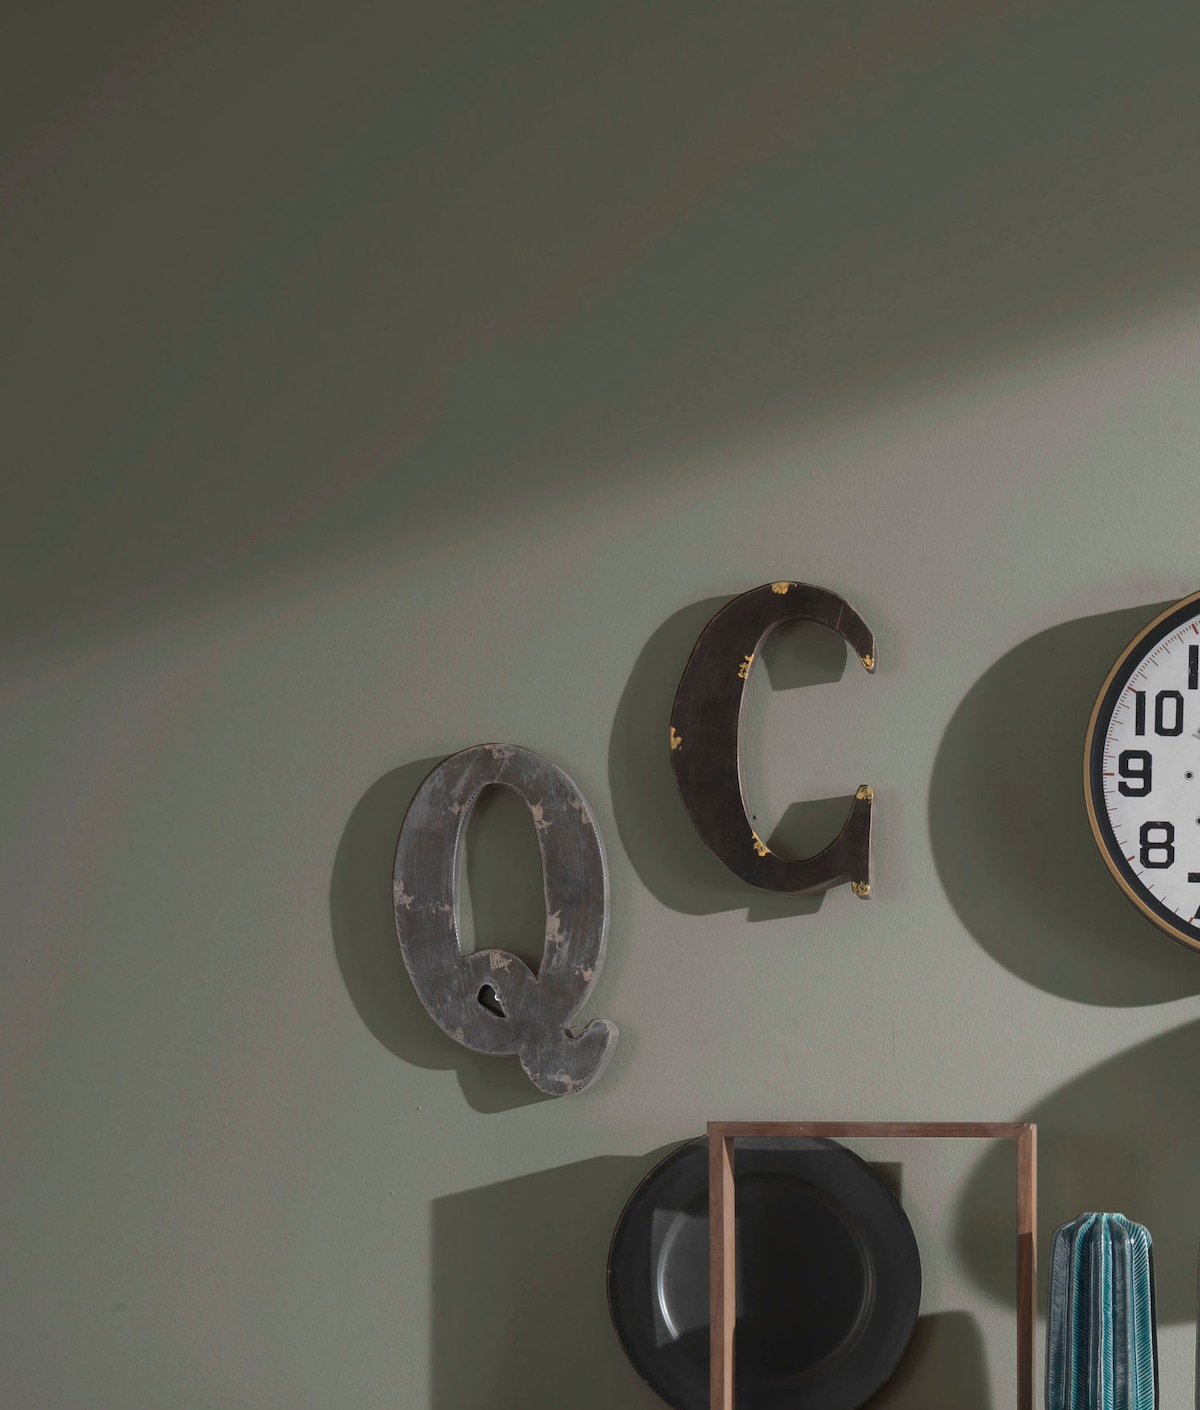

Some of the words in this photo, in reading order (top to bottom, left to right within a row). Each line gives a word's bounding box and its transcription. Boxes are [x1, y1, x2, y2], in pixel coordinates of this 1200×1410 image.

[1134, 689, 1184, 737] 10
[1117, 749, 1152, 798] 9
[1139, 820, 1175, 869] 8
[392, 742, 617, 1096] Q
